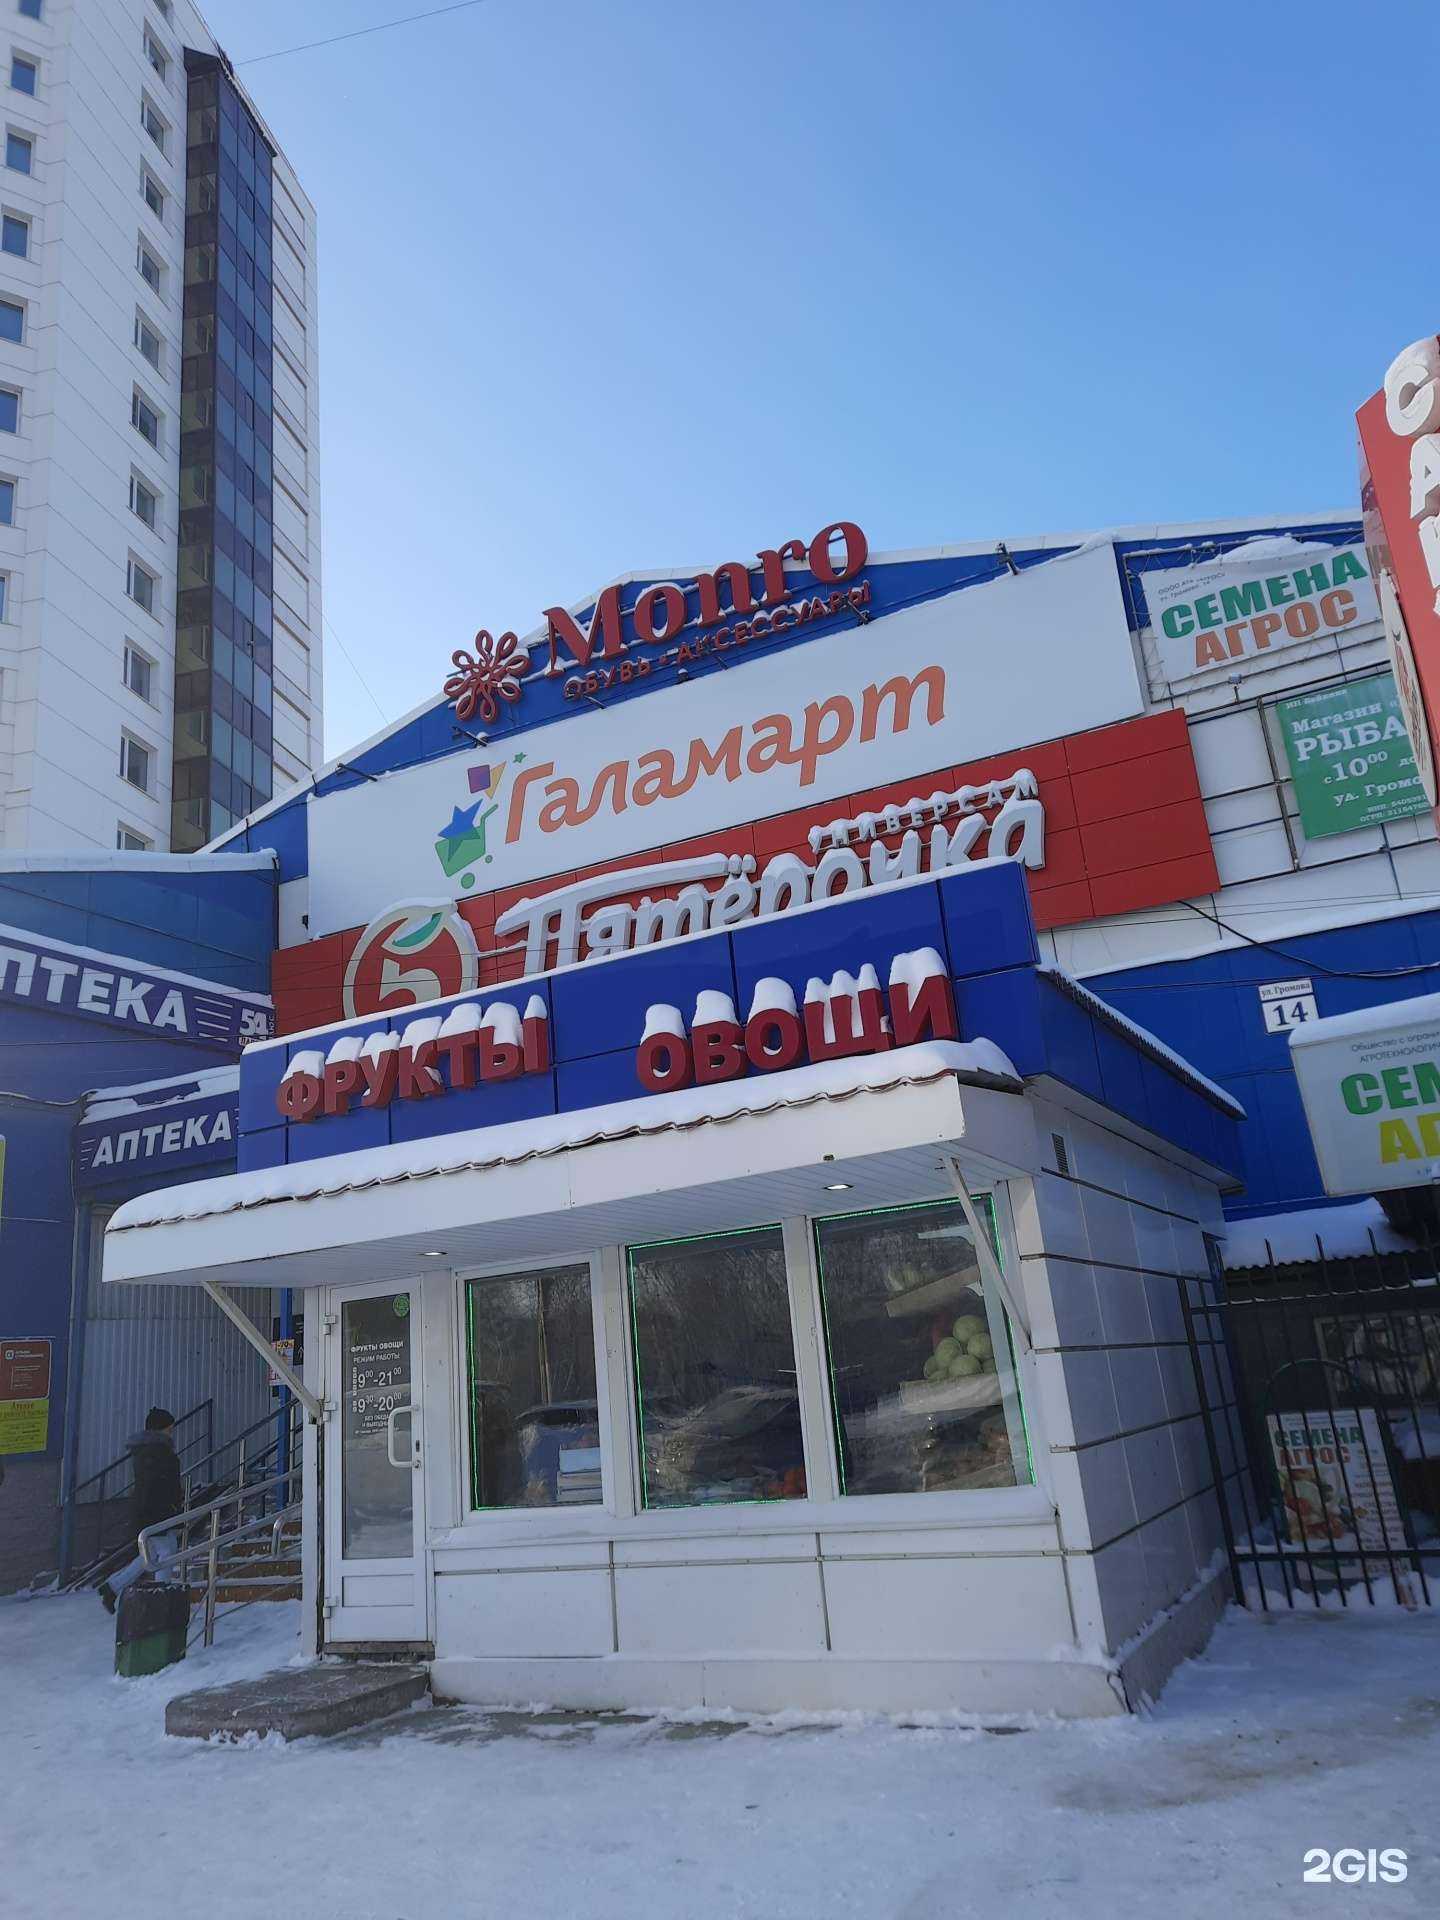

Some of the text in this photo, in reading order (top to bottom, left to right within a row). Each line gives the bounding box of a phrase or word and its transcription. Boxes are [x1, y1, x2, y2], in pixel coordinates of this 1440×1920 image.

[543, 521, 868, 679] Monro
[1161, 550, 1369, 640] СЕМЕНА
[563, 580, 872, 700] ОБУВЬ АКСЕССУАРЫ
[1195, 589, 1358, 668] АГРОС
[1291, 703, 1383, 735] Магазин
[1294, 715, 1408, 762] РЫБА
[505, 664, 946, 845] Галамарт
[1333, 775, 1426, 807] ул. Громо
[0, 944, 188, 1034] ПТЕКА
[1272, 1001, 1309, 1026] 14
[240, 1007, 269, 1036] 54
[275, 960, 957, 1124] ФРУКТЫ ОВОЩИ
[1341, 1061, 1440, 1115] СЕМ
[92, 1110, 232, 1168] АПТЕКА
[1379, 1112, 1440, 1165] АГ
[351, 1340, 404, 1353] ФРУКТЫ ОВОЩИ
[353, 1355, 375, 1363] РЕЖИМ
